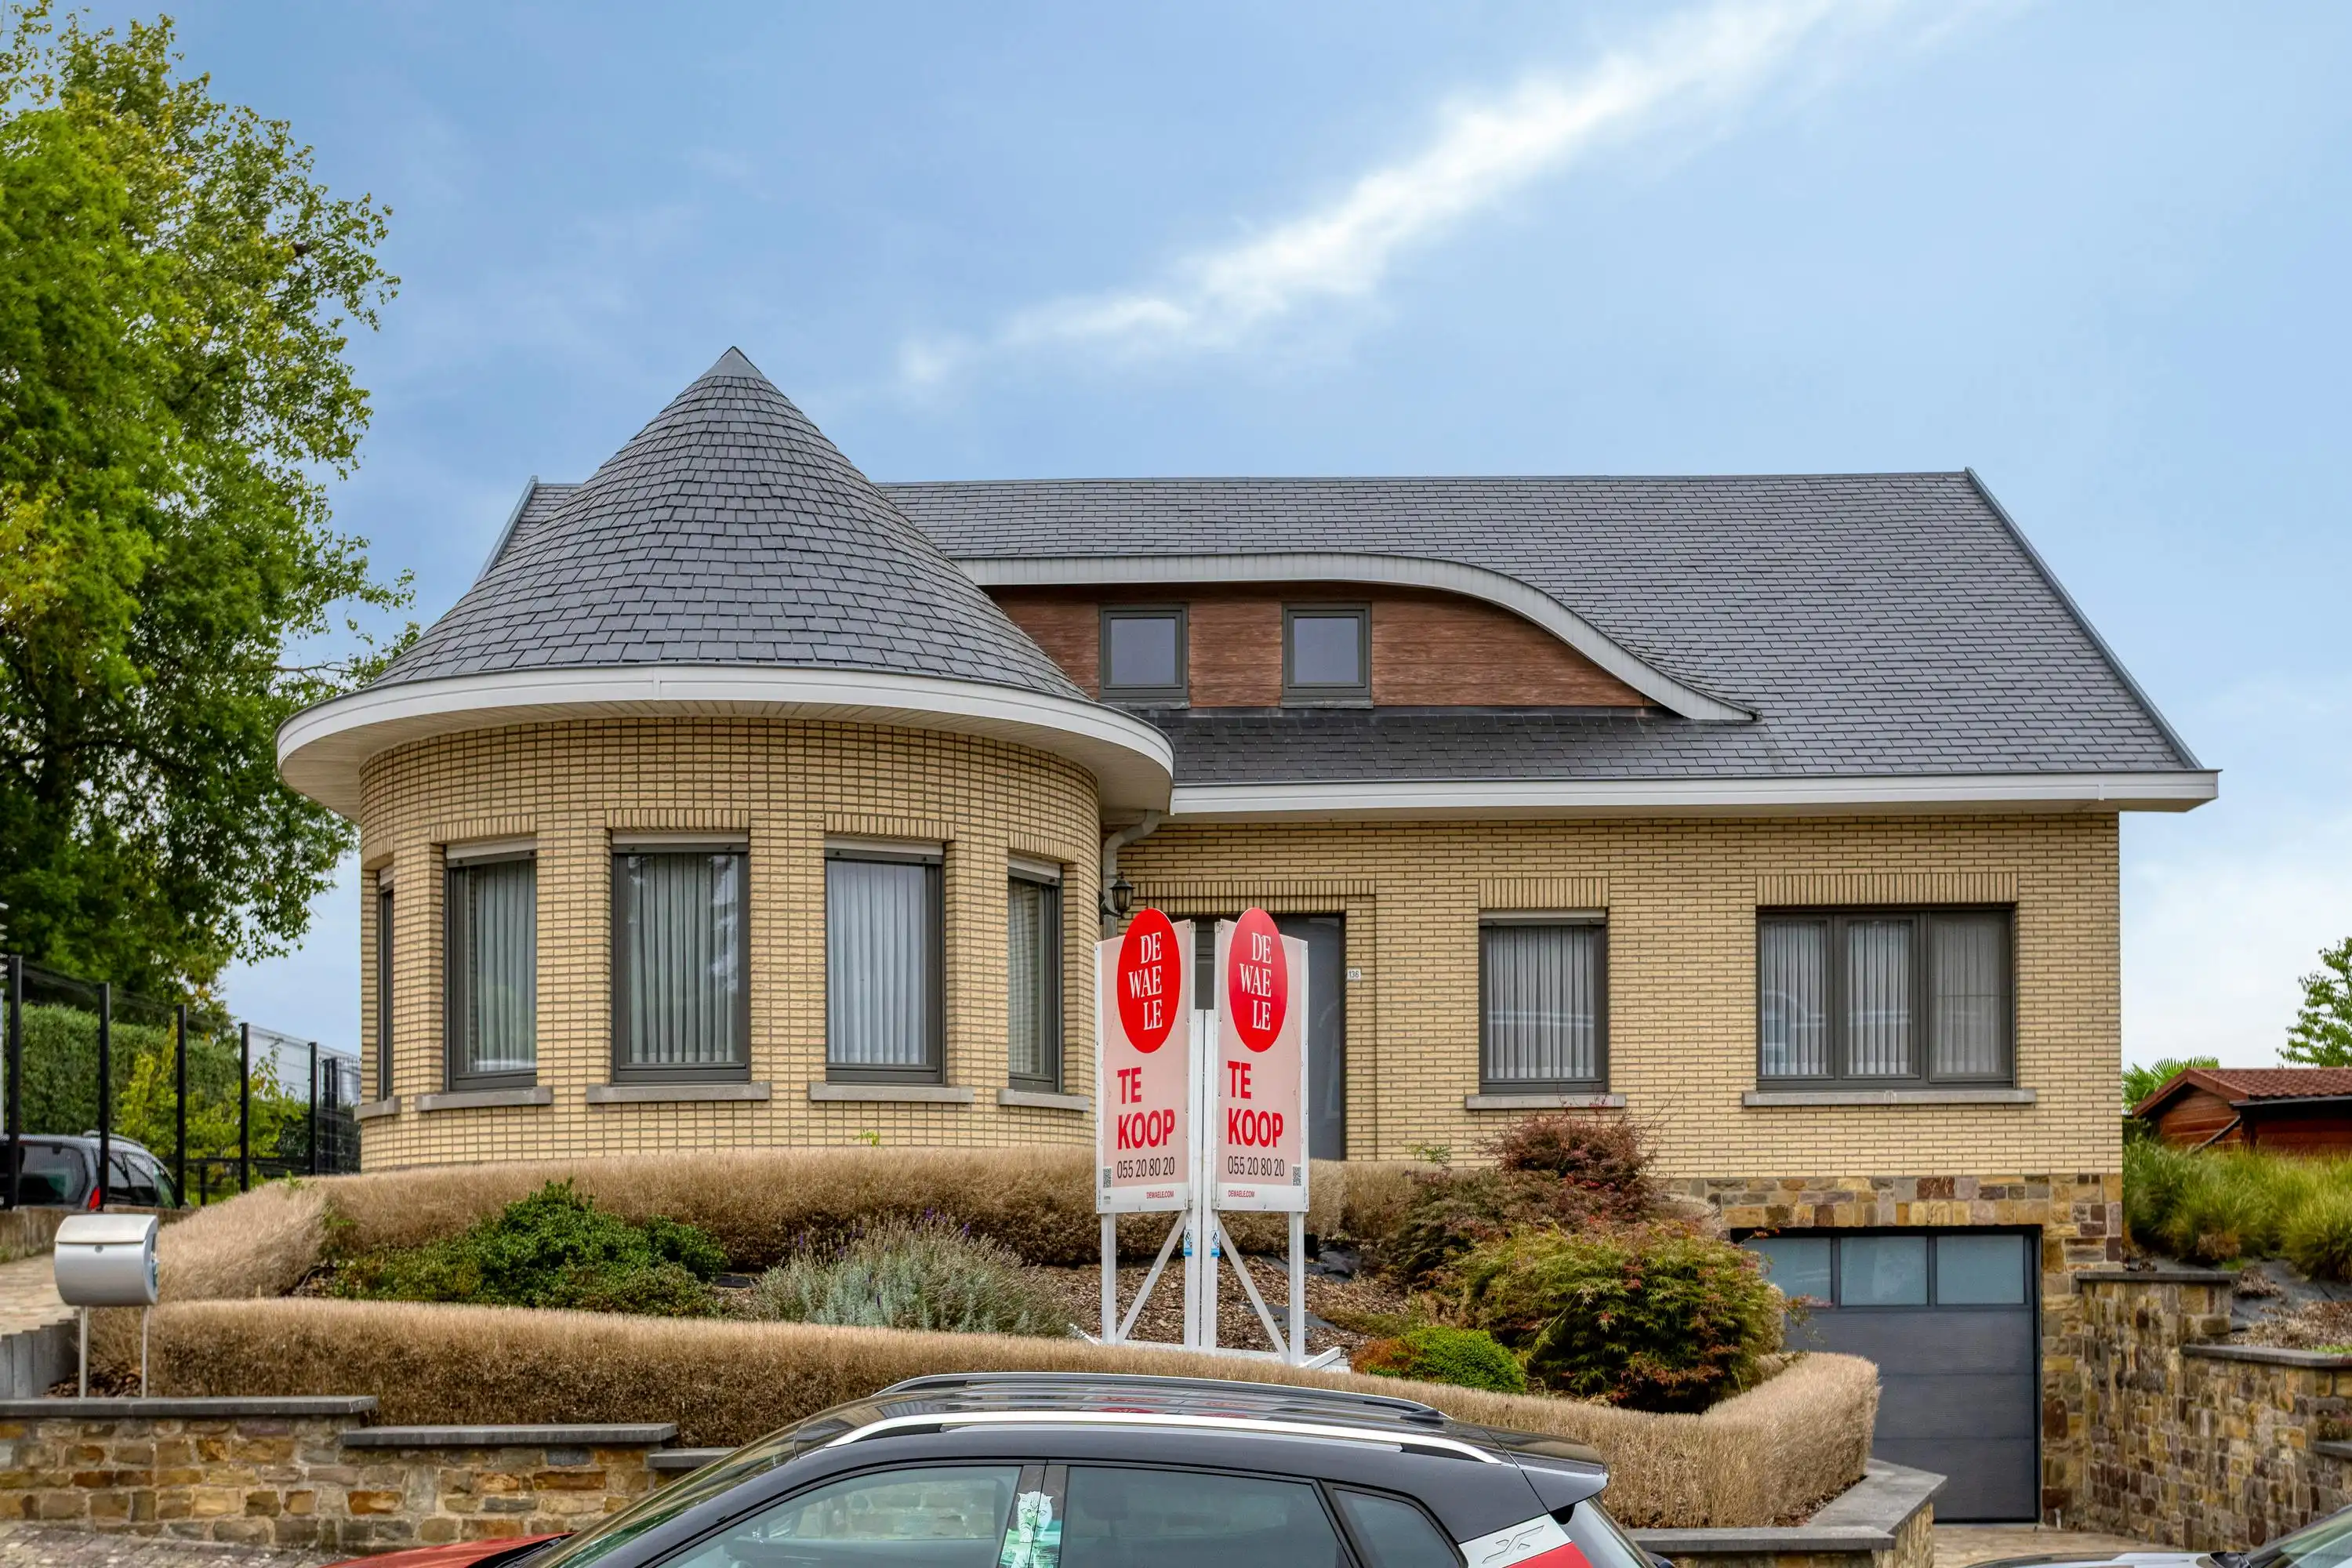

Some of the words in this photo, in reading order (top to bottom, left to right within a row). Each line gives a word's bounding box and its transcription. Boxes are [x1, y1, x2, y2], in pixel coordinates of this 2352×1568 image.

[1140, 931, 1161, 964] DE
[1251, 932, 1272, 964] DE
[1128, 965, 1162, 1000] WAE
[1239, 963, 1272, 998] WAE
[1143, 999, 1163, 1031] LE
[1252, 1000, 1271, 1031] LE
[1117, 1066, 1142, 1105] TE
[1227, 1060, 1251, 1100] TE
[1117, 1109, 1175, 1150] KOOP
[1228, 1107, 1283, 1148] KOOP
[1116, 1160, 1134, 1179] 055
[1135, 1158, 1147, 1178] 20
[1149, 1156, 1161, 1177] 80
[1163, 1156, 1175, 1176] 20
[1228, 1155, 1245, 1175] 055
[1247, 1156, 1258, 1176] 20
[1261, 1157, 1272, 1177] 80
[1273, 1158, 1285, 1177] 20
[1146, 1190, 1174, 1200] DEWAELE.COM
[1228, 1189, 1255, 1198] DEWAELE.COM
